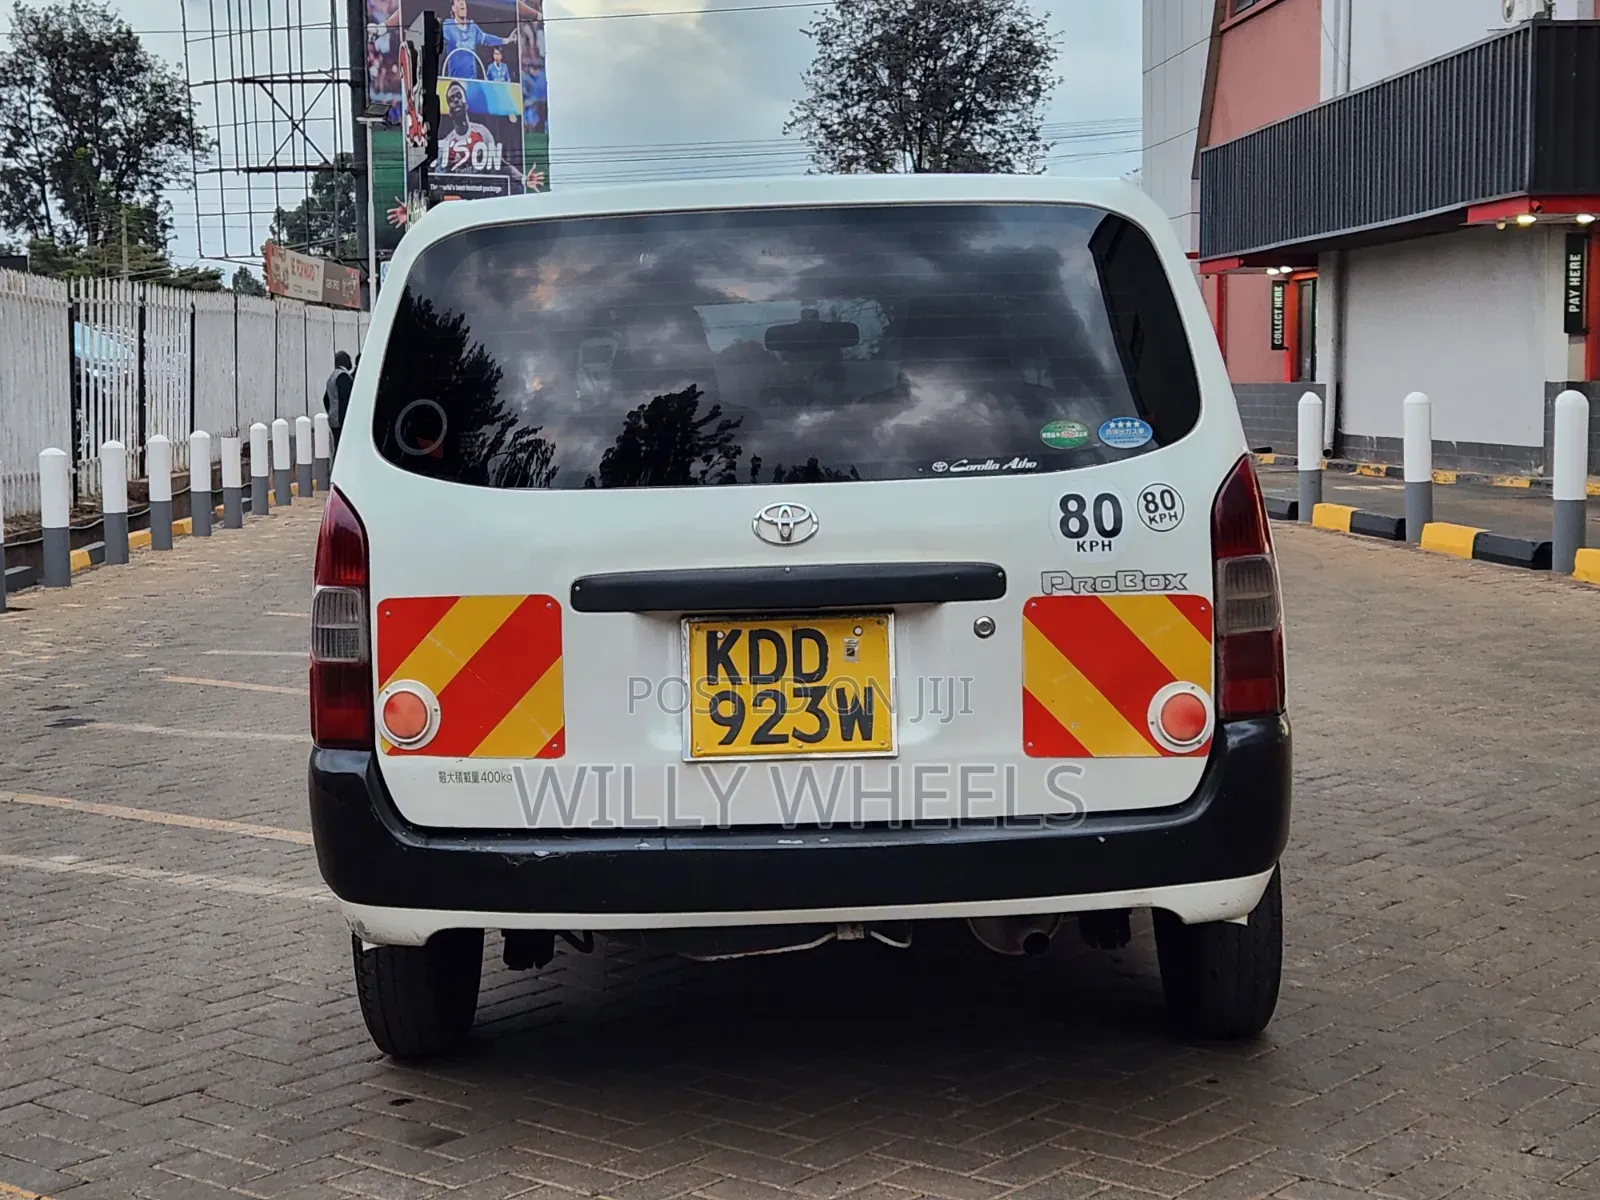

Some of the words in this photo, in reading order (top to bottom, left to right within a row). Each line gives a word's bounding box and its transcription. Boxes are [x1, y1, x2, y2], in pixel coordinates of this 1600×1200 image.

[471, 141, 503, 171] ON
[1568, 253, 1582, 287] HERE
[1273, 285, 1283, 308] HERE
[1568, 289, 1581, 313] PAY
[1273, 308, 1283, 345] COLLECT
[949, 459, 1000, 472] Corolla
[1143, 489, 1176, 514] 80
[1059, 492, 1123, 539] 80
[1148, 511, 1178, 525] KPH
[1076, 540, 1112, 552] KPH
[706, 628, 830, 686] KDD
[709, 686, 874, 746] 923W
